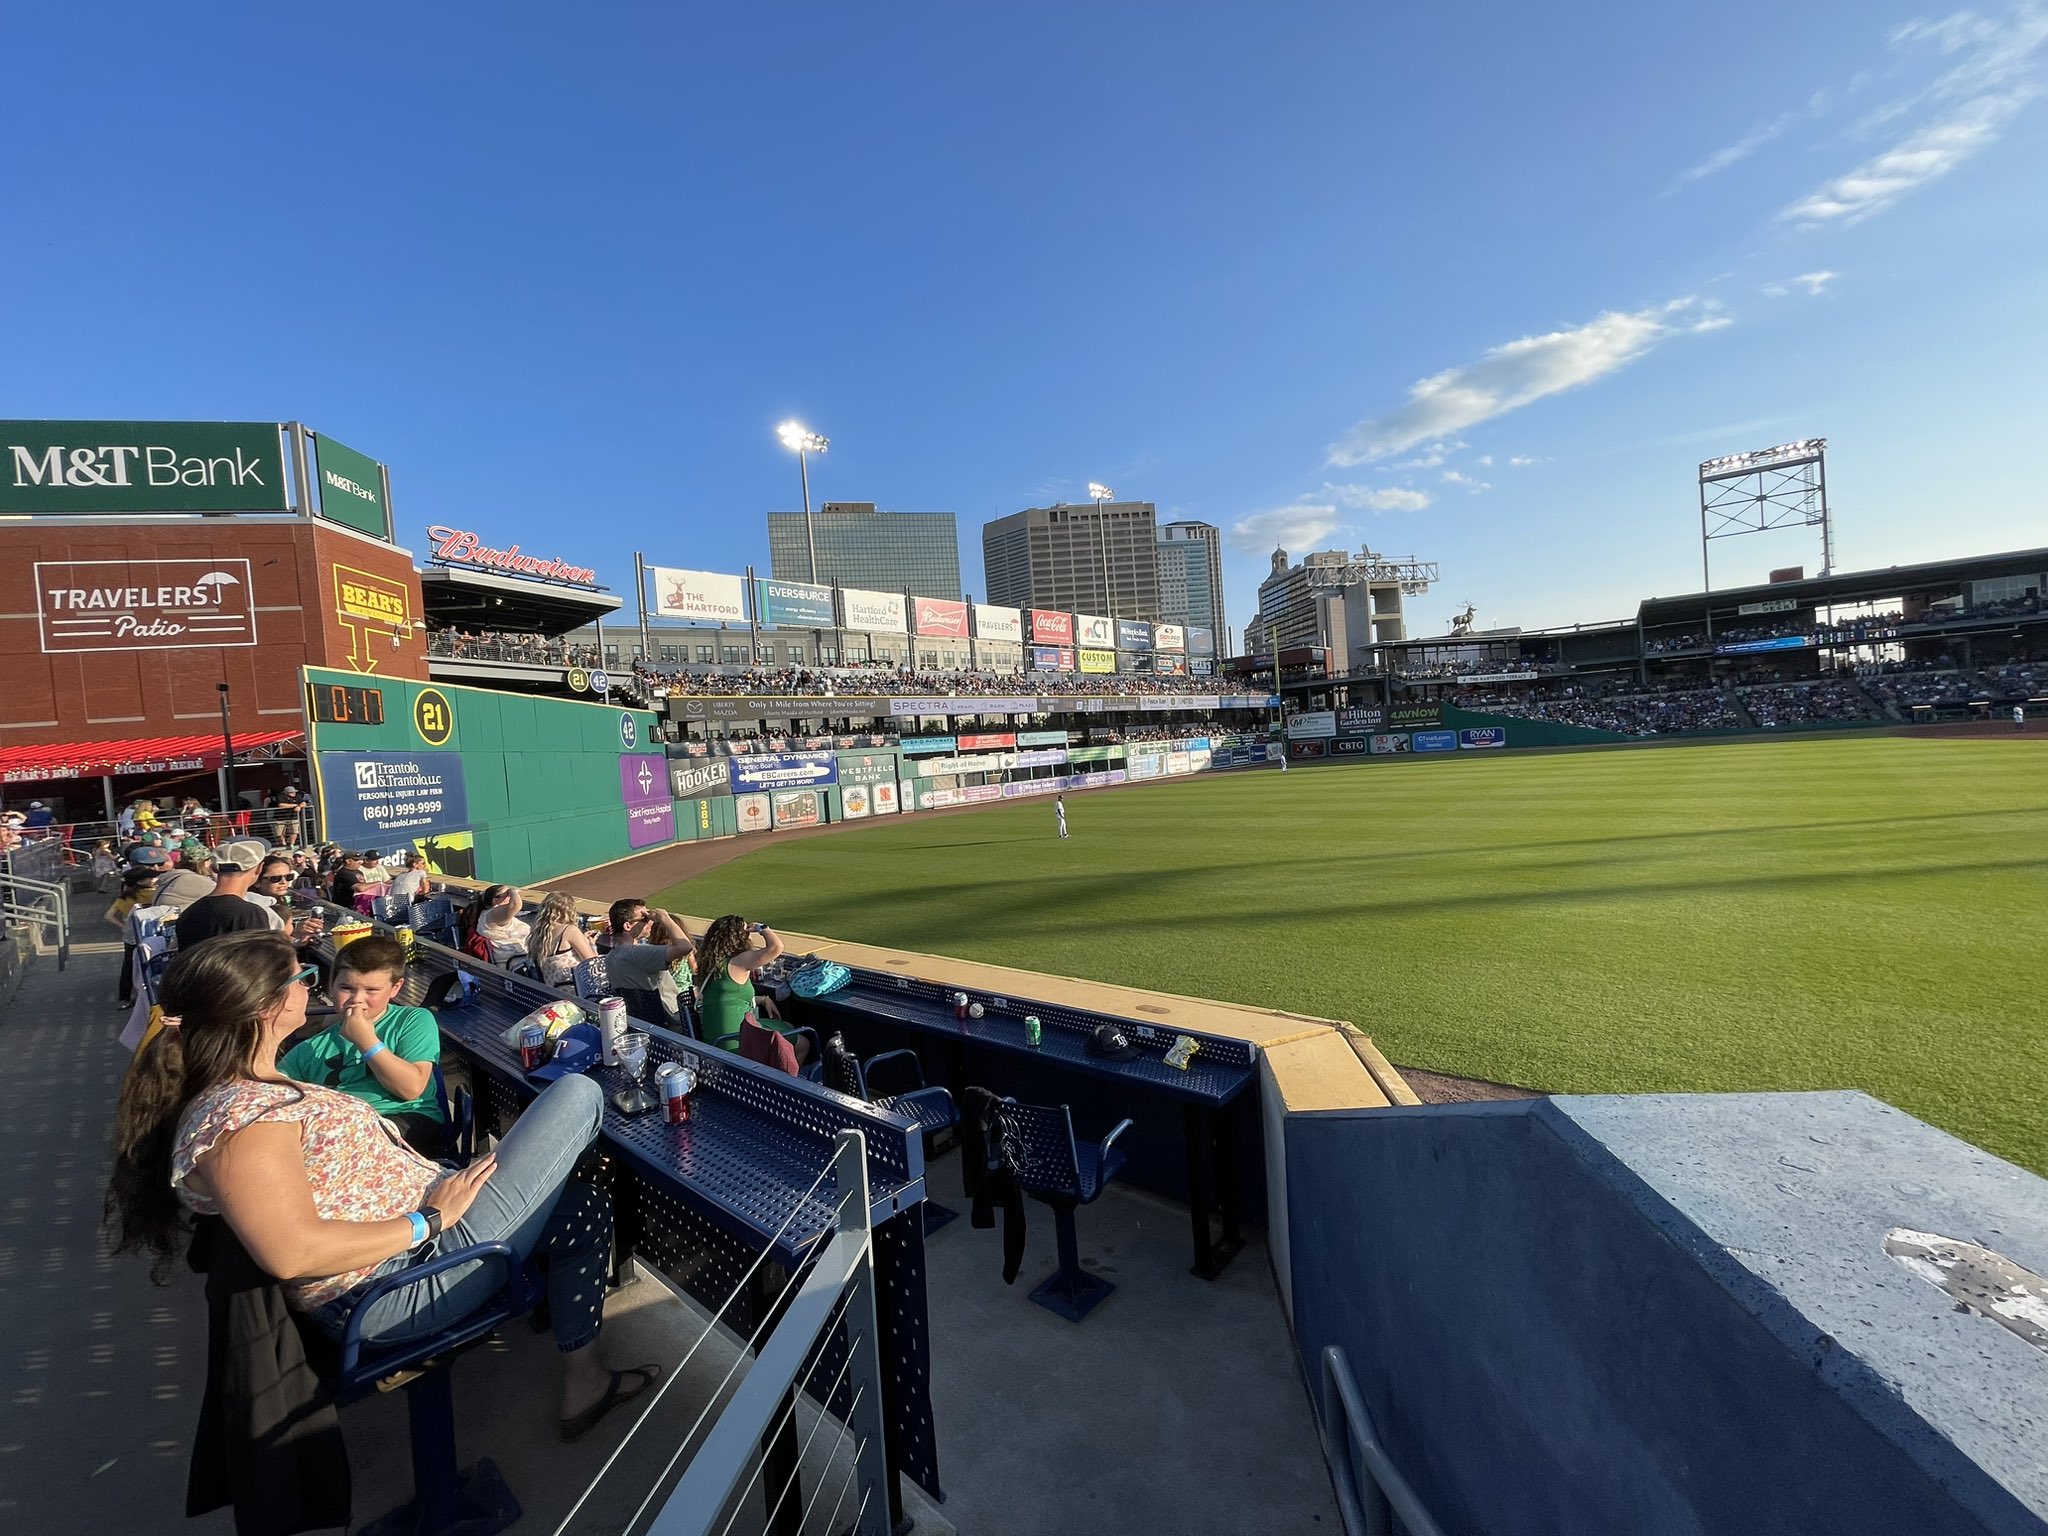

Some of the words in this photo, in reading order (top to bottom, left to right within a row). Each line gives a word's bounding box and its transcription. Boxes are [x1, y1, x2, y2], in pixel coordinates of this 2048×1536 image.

[8, 446, 139, 487] M&T
[146, 446, 265, 487] Bank
[326, 470, 353, 492] M&T
[352, 482, 376, 504] Bank
[428, 525, 595, 584] Budweiser
[48, 585, 208, 610] TRAVELERS
[342, 584, 403, 615] BEAR'S
[686, 592, 704, 601] THE
[768, 586, 829, 602] EVERSOURCE
[686, 603, 739, 614] HARTFORD
[852, 604, 887, 615] Hartford
[115, 615, 186, 638] Patio
[853, 614, 898, 627] HealthCare
[978, 621, 1013, 631] TRAVELERS
[1081, 652, 1113, 662] CUSTOM
[572, 674, 585, 686] 21
[593, 675, 606, 687] 42
[748, 701, 767, 710] Only
[811, 700, 832, 708] Where
[854, 700, 876, 709] Sitting!
[893, 701, 949, 710] SPECTRA
[422, 703, 444, 731] 21
[1349, 709, 1381, 719] Hilton
[1340, 718, 1367, 726] Garden
[623, 722, 635, 740] 42
[1470, 729, 1495, 739] RYAN
[1339, 741, 1364, 750] CBTG
[737, 756, 781, 764] GENERAL
[783, 752, 830, 761] DYNAMICS
[52, 768, 79, 779] BBQ
[115, 763, 147, 774] PICK
[150, 762, 166, 772] UP
[169, 760, 204, 770] HERE
[376, 761, 419, 775] Trantolo
[839, 765, 895, 775] WESTFIELD
[677, 763, 727, 791] HOOKER
[761, 769, 814, 780] EBCareers.com
[855, 774, 881, 782] BANK
[759, 781, 776, 789] LET'S
[358, 791, 394, 801] PERSONAL
[396, 790, 415, 799] INJURY
[363, 804, 394, 821] (860)
[396, 800, 442, 816] 999-9999
[700, 800, 709, 829] 388
[378, 817, 432, 830] TrantoloLaw.com
[378, 848, 407, 867] red?
[523, 1035, 545, 1048] AHA
[553, 1039, 568, 1059] T
